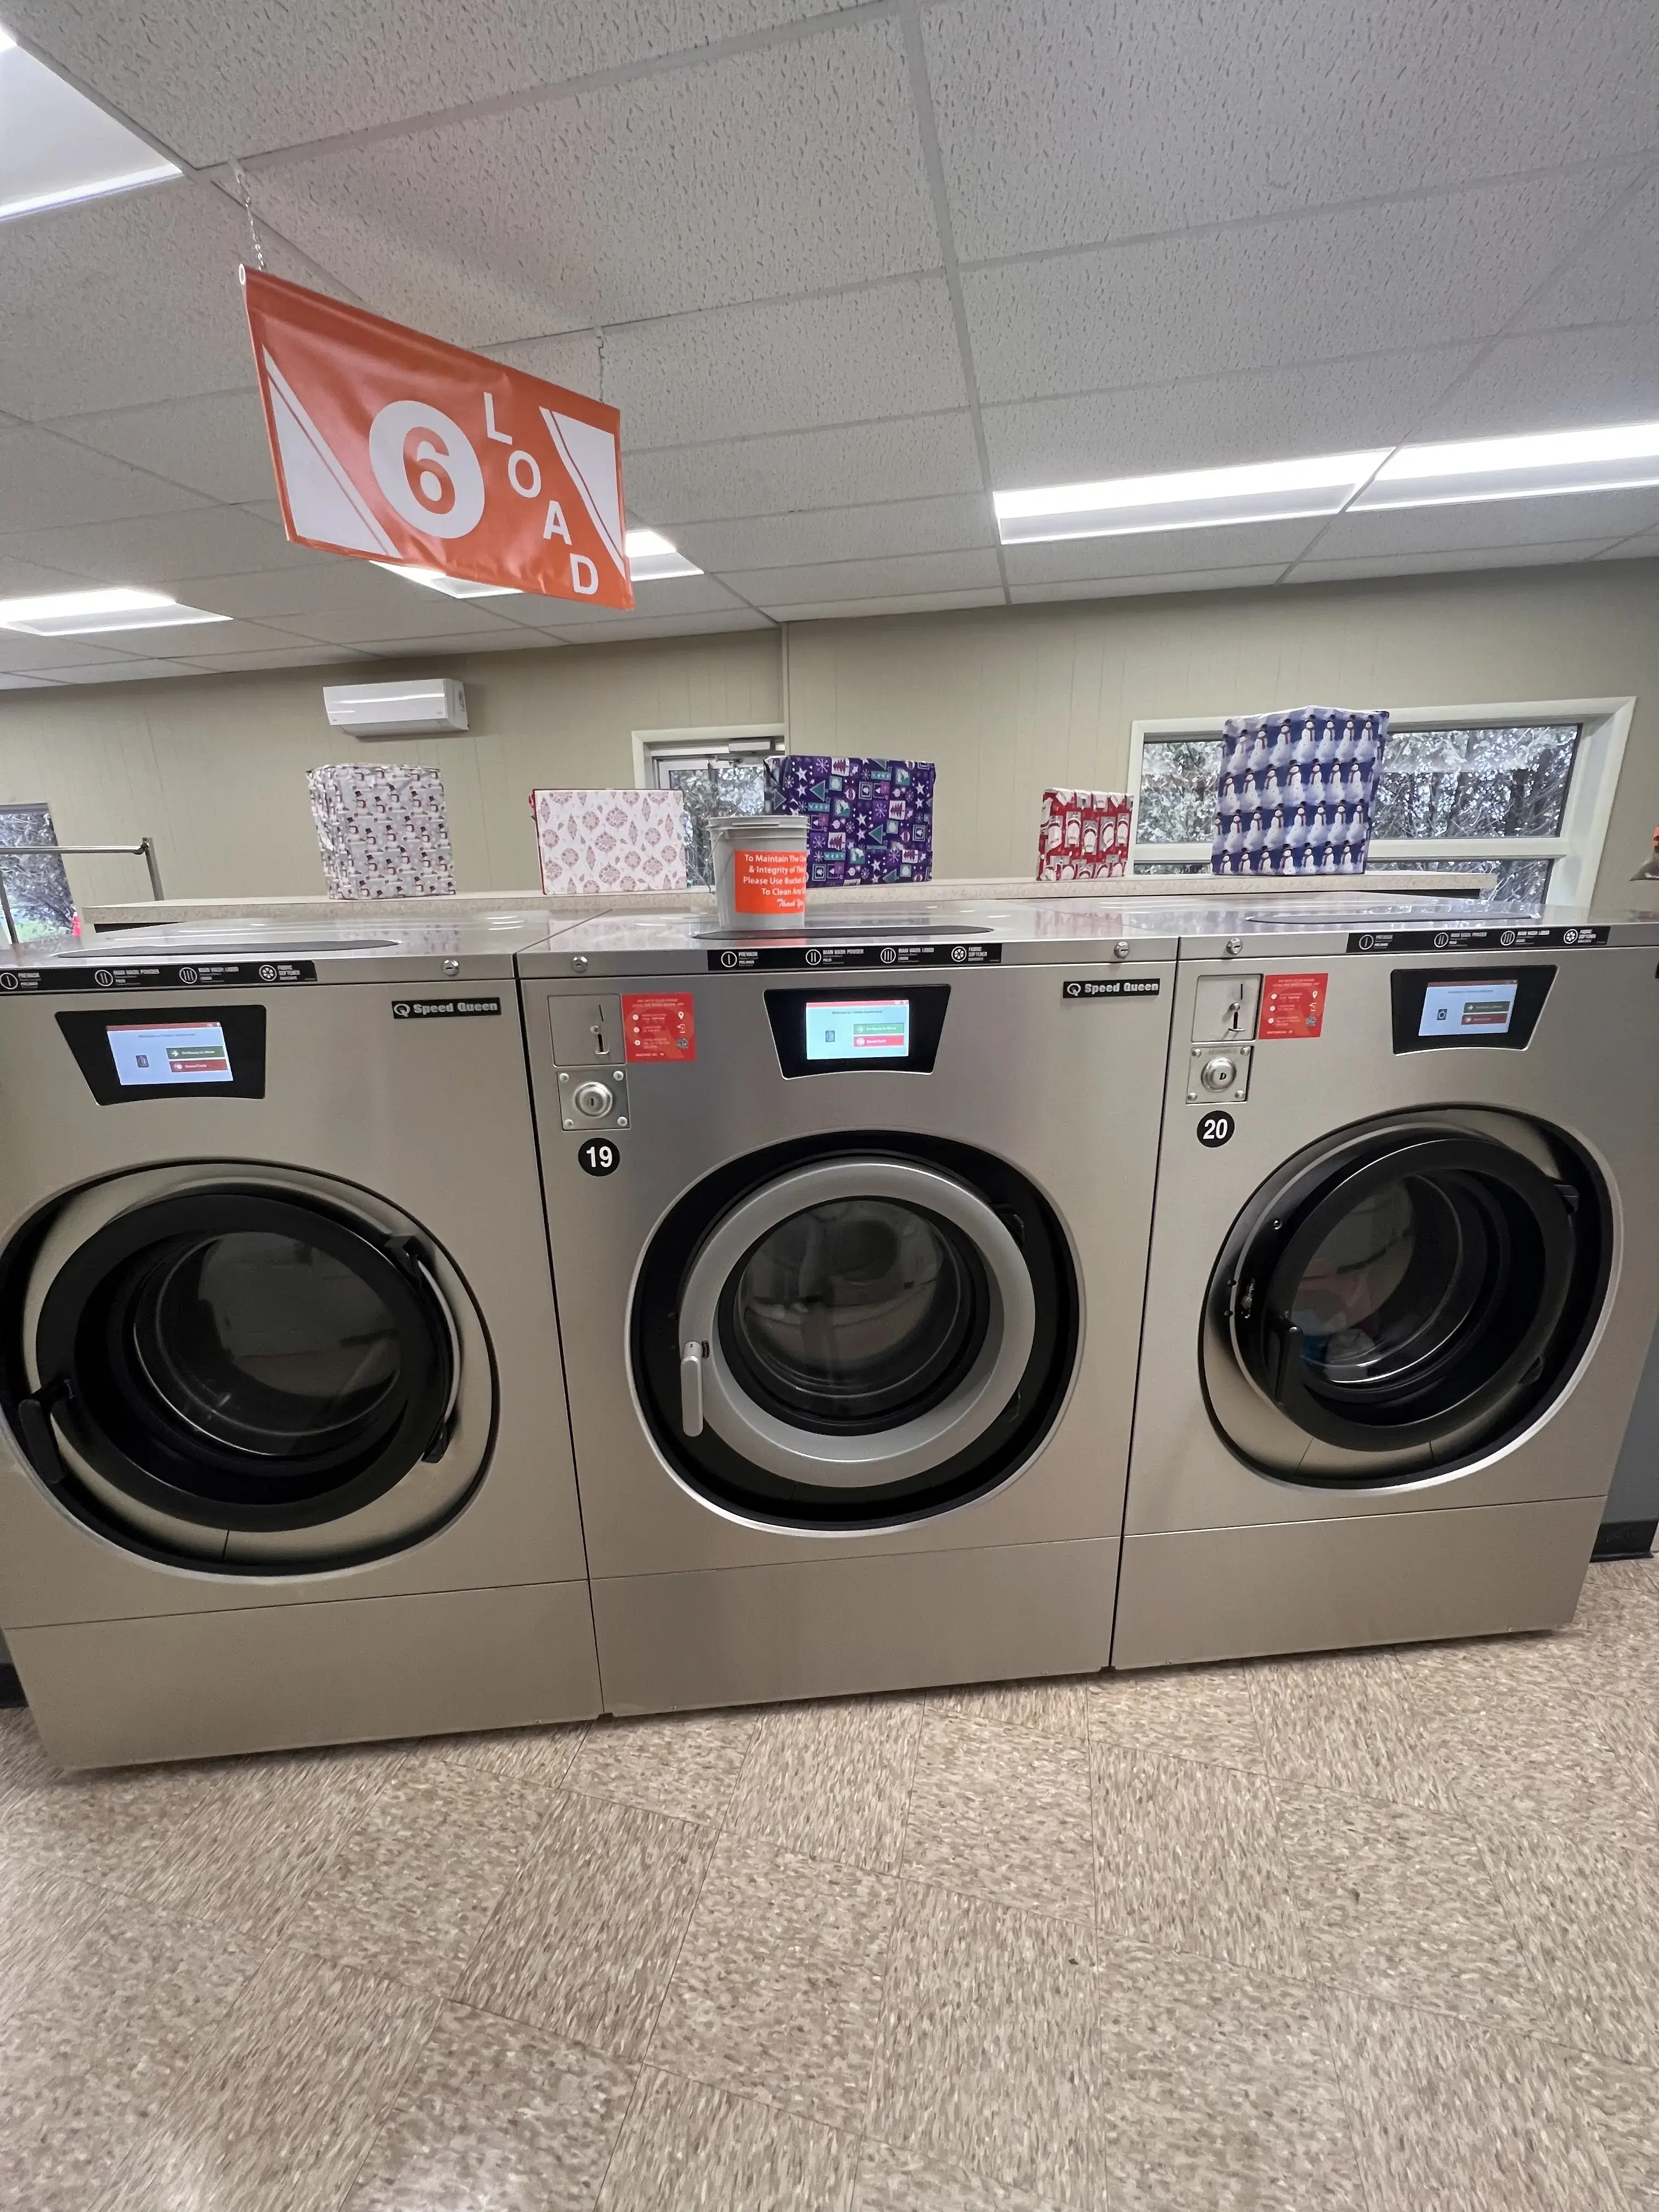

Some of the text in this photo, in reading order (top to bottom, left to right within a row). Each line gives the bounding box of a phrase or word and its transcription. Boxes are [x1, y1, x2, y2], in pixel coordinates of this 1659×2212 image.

[402, 426, 456, 516] 6
[483, 392, 599, 595] LOAD
[755, 854, 789, 863] Maintain
[749, 865, 755, 873] &
[757, 866, 789, 876] Integrity
[743, 876, 768, 884] Please
[770, 877, 783, 885] Use
[761, 888, 771, 896] To
[772, 888, 792, 896] Clean
[1084, 983, 1120, 995] Speed
[1123, 982, 1159, 992] Queen
[413, 1003, 454, 1015] Speed
[457, 1002, 498, 1012] Queen
[1203, 1118, 1228, 1140] 20
[586, 1146, 613, 1168] 19
